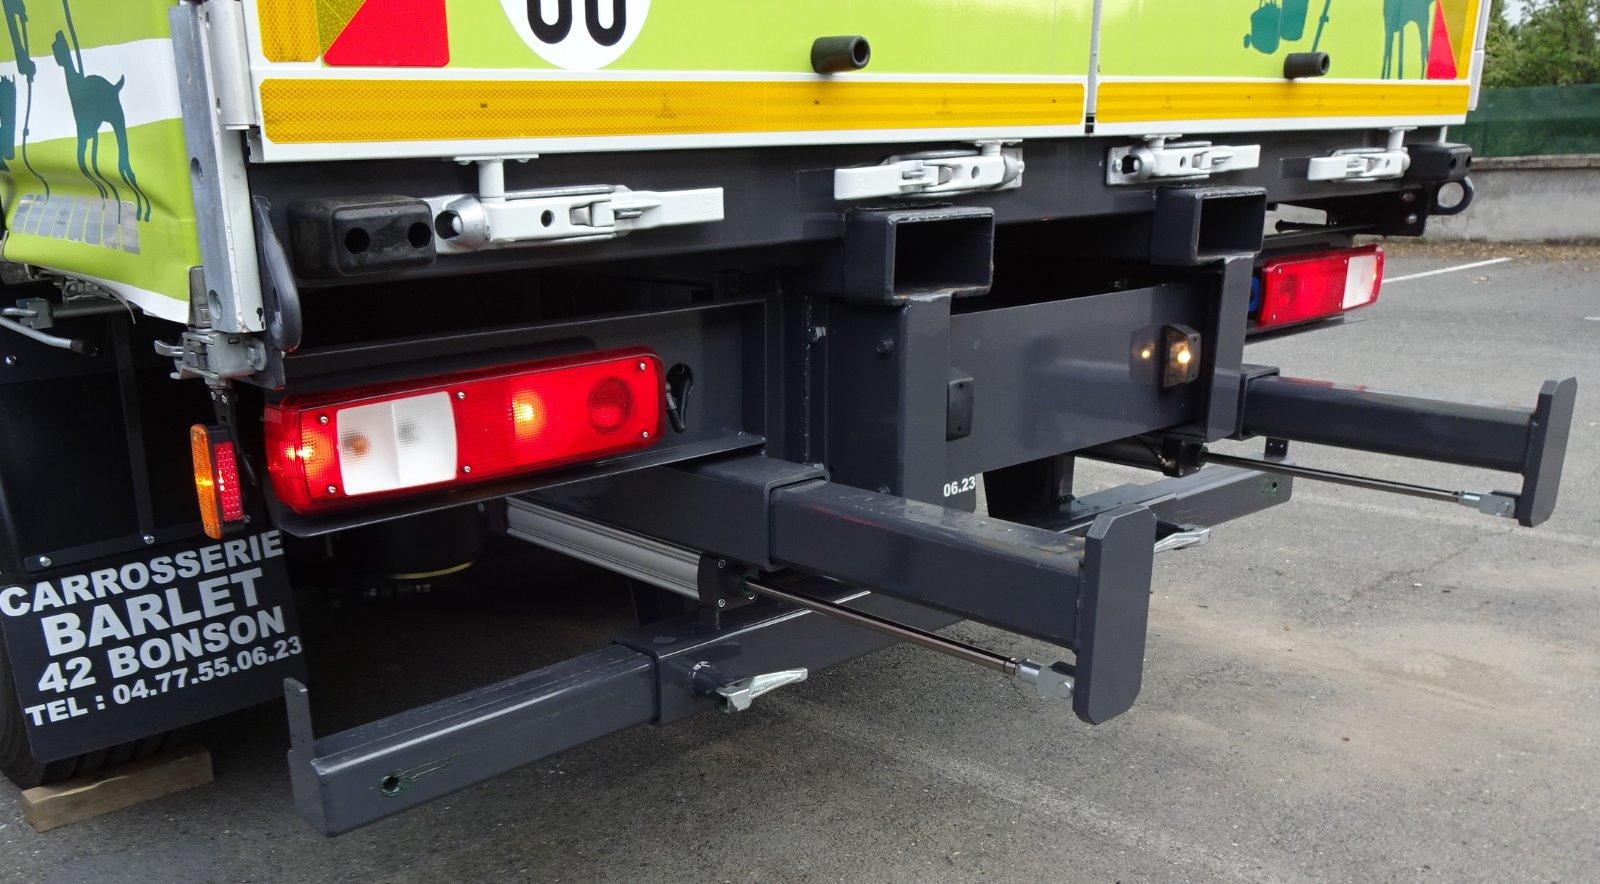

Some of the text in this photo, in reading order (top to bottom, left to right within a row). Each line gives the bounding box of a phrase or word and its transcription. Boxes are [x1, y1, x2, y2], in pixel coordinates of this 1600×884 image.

[0, 529, 284, 617] CARROSSERIE
[41, 567, 263, 656] BARLET
[25, 697, 88, 727] TEL
[112, 636, 303, 705] 04.77.55.06.23
[37, 606, 286, 693] 42 BONSON
